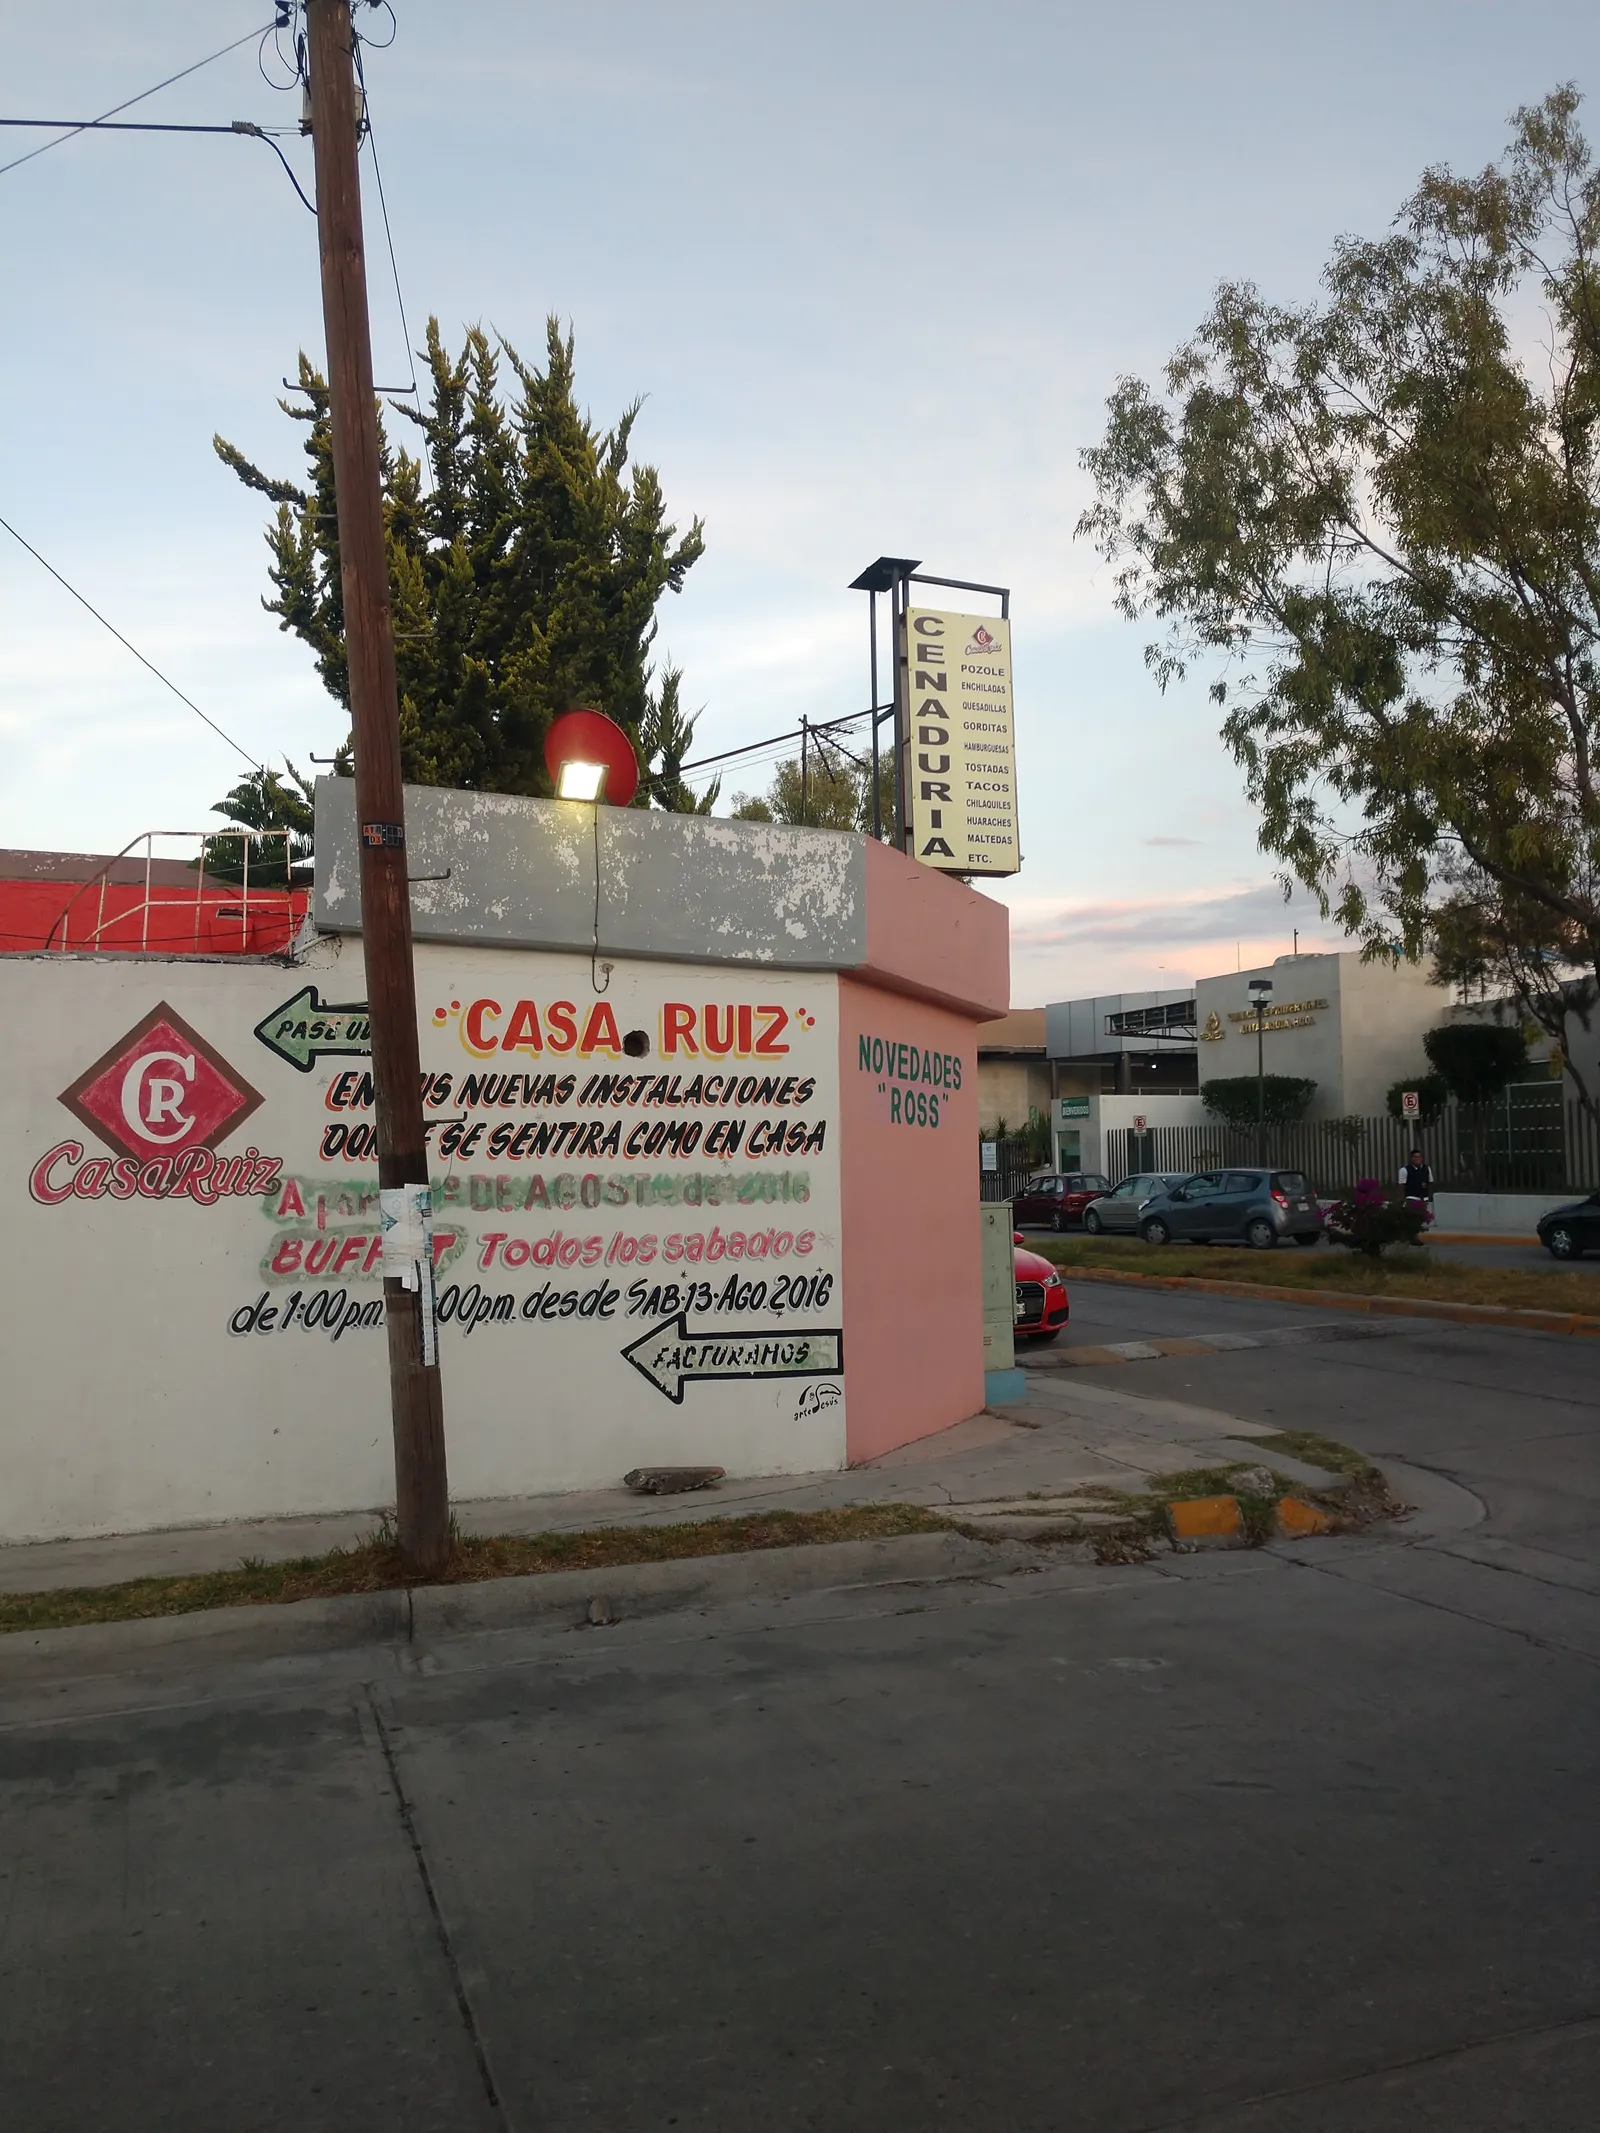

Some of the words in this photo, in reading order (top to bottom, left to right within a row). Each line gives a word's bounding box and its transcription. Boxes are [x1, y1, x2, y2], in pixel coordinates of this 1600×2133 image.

[961, 664, 1005, 677] POZOLE
[961, 682, 1006, 694] ENCHILADAS
[962, 701, 1007, 714] QUESADILLAS
[963, 721, 1008, 733] GORDITAS
[913, 616, 955, 858] CENADURIA
[964, 742, 1009, 754] HAMBURGUESAS
[965, 763, 1009, 775] TOSTADAS
[966, 781, 1010, 793] TACOS
[966, 799, 1011, 810] CHILAQUILES
[967, 816, 1012, 828] HUARACHES
[967, 834, 1013, 845] MALTEDAS
[968, 853, 993, 864] ETC.
[275, 1020, 341, 1041] PASE
[463, 998, 621, 1056] CASA
[661, 1001, 790, 1057] RUIZ
[858, 1034, 963, 1090] NOVEDADES
[457, 1072, 577, 1107] NUEVAS
[578, 1073, 816, 1108] INSTALACIONES
[439, 1122, 487, 1158] SE
[488, 1120, 620, 1158] SENTIRA
[625, 1121, 705, 1157] COMO
[706, 1122, 742, 1155] EN
[748, 1120, 827, 1157] CASA
[277, 1177, 305, 1218] A
[482, 1228, 603, 1267] Todos
[608, 1230, 658, 1265] los
[663, 1225, 816, 1262] sabados
[232, 1291, 279, 1335] de
[523, 1278, 620, 1319] desde
[652, 1340, 811, 1371] FACTURAMOS
